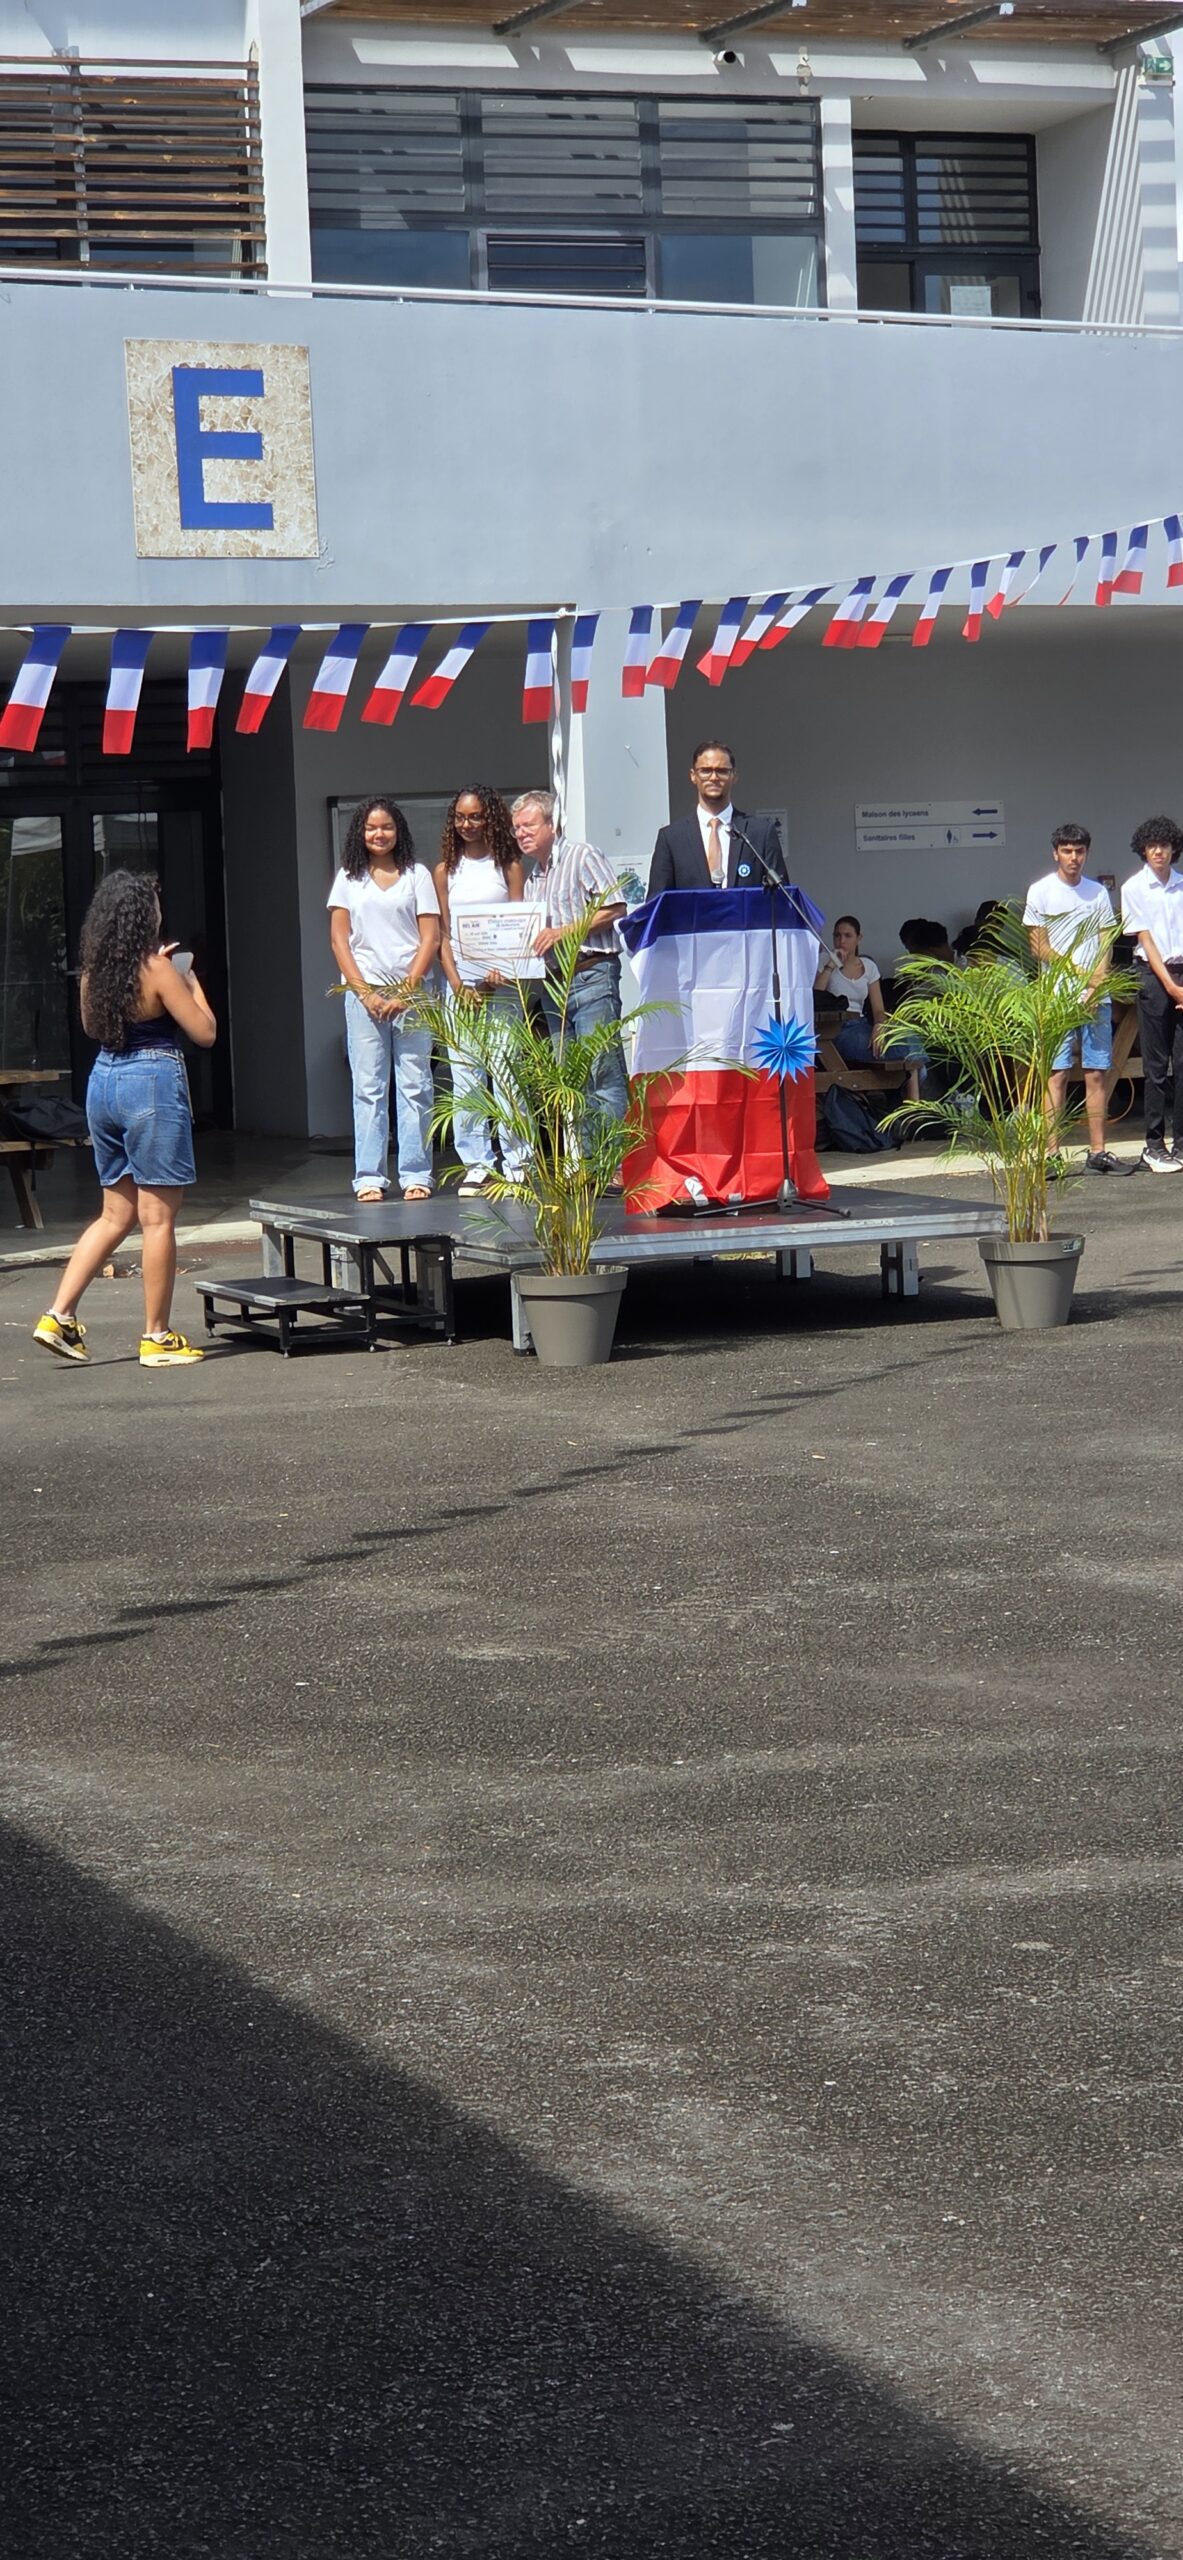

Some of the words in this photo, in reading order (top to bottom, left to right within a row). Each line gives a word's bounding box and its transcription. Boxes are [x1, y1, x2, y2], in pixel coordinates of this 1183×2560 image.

[172, 367, 274, 530] E
[863, 834, 897, 842] Sanitaires
[898, 833, 915, 841] filles
